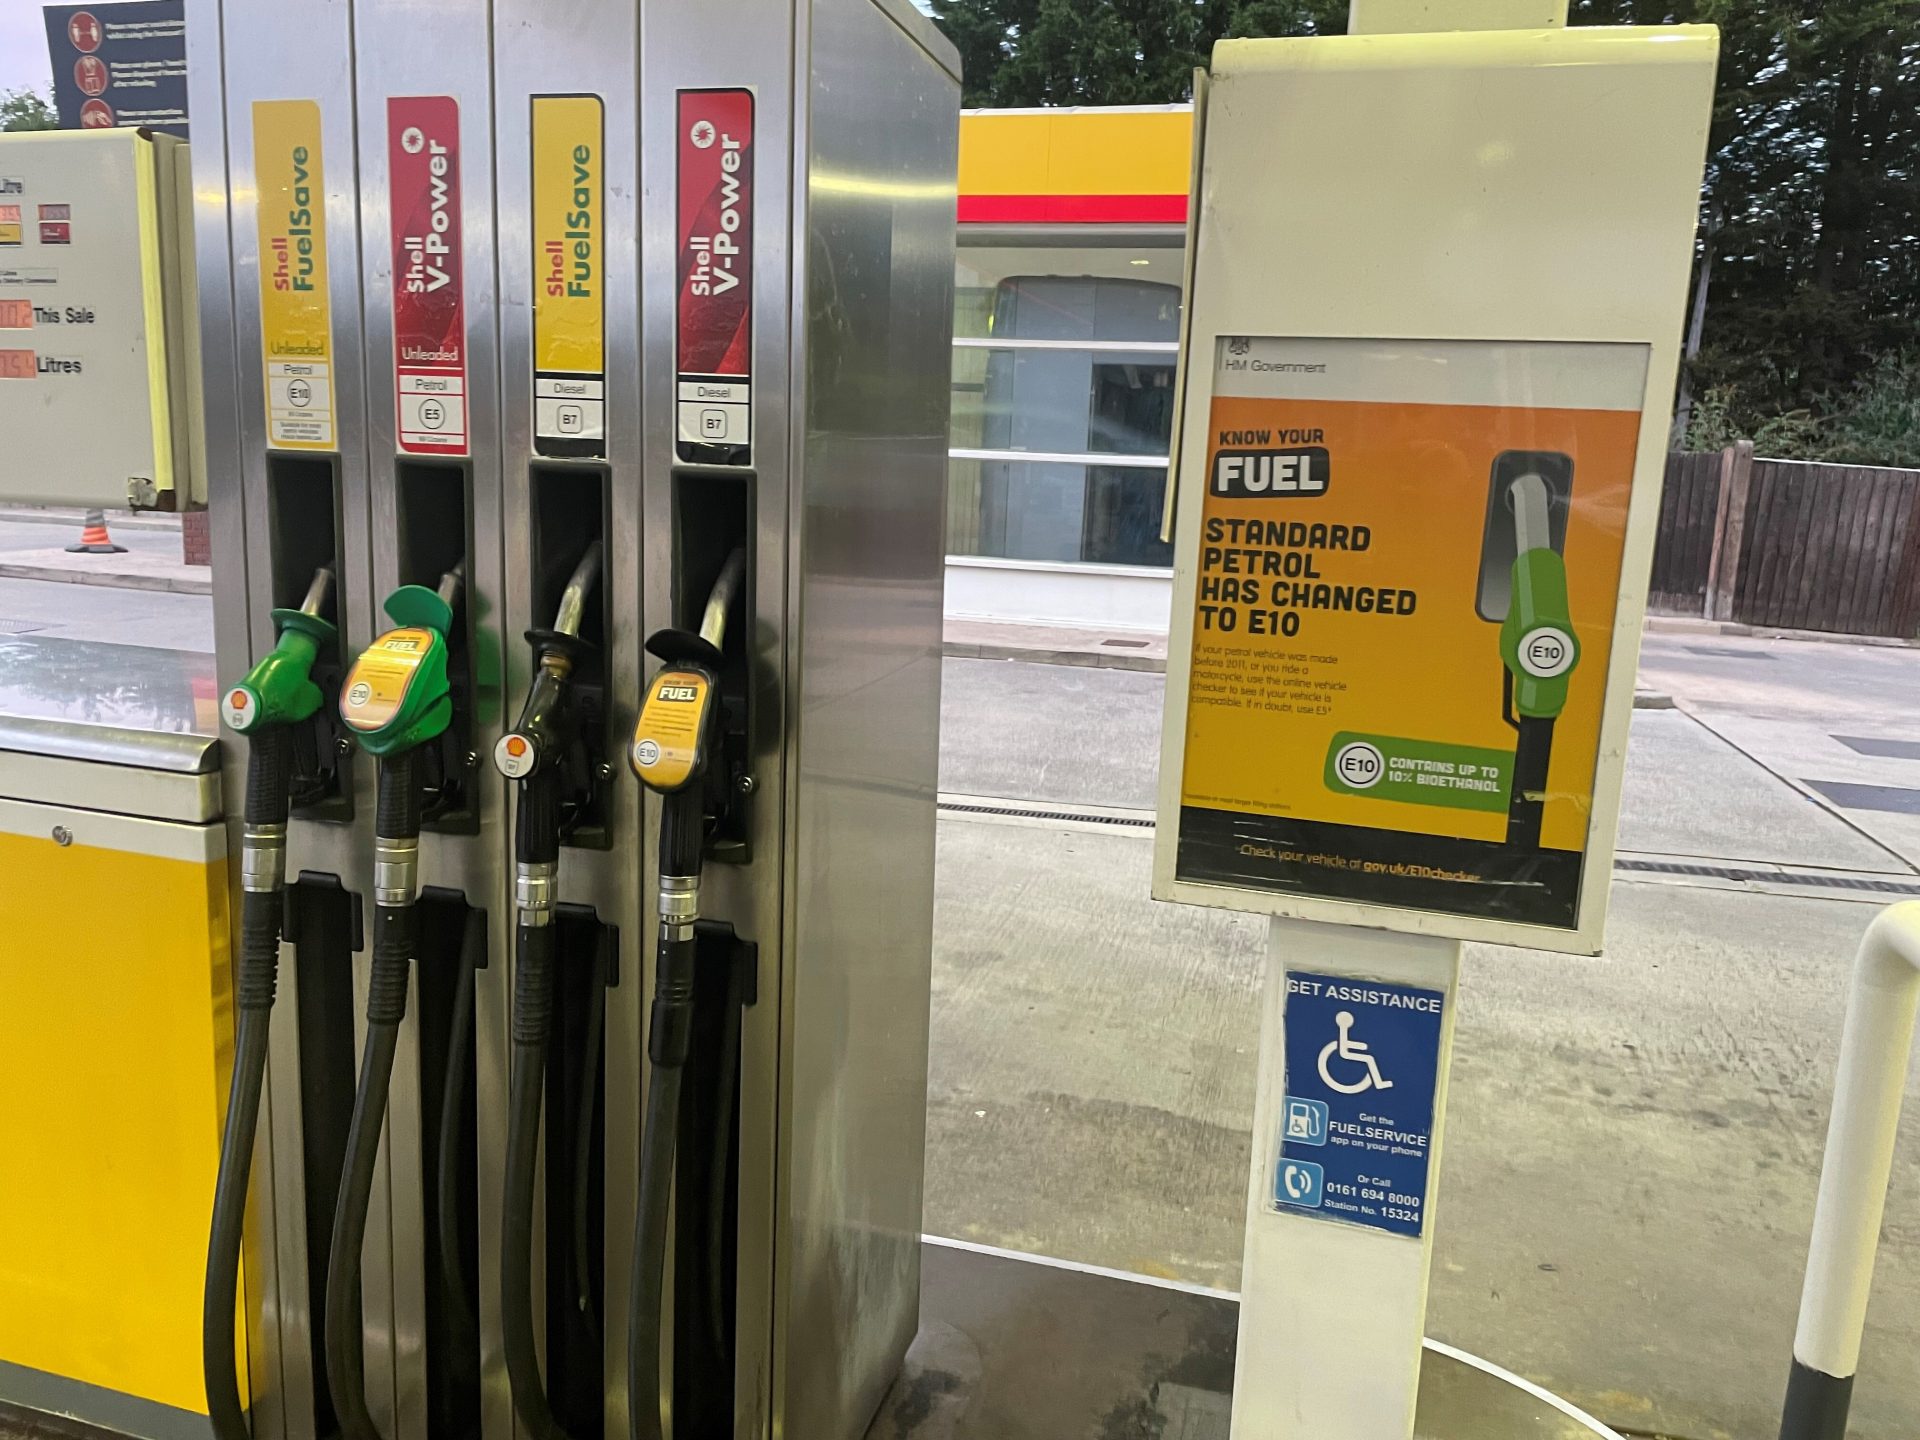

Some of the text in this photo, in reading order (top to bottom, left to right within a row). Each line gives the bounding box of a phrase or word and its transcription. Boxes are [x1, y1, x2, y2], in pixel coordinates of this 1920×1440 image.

[288, 146, 315, 291] FuelSave
[426, 139, 450, 292] V-Power
[565, 145, 591, 298] FuelSave
[713, 134, 740, 296] V-Power
[271, 238, 290, 291] Shell
[404, 237, 424, 293] Shell
[545, 241, 564, 297] Shell
[690, 236, 710, 296] Shell
[33, 307, 94, 323] This Sale
[271, 340, 325, 355] Unleaded
[402, 345, 458, 361] Unleaded
[37, 356, 82, 373] Litres
[284, 364, 313, 375] Petrol
[1225, 359, 1327, 373] HM Government
[290, 388, 310, 399] E10
[415, 378, 447, 391] Petrol
[553, 383, 586, 394] Diesel
[697, 387, 731, 398] Diesel
[425, 409, 440, 420] E5
[563, 415, 577, 424] B7
[706, 419, 722, 429] B7
[1219, 429, 1324, 445] KNOW YOUR
[1218, 455, 1324, 492] FUEL
[1205, 517, 1371, 551] STANDARD
[1203, 547, 1320, 579] PETROL
[1201, 576, 1417, 616] HAS CHANGED
[1199, 606, 1300, 637] TO E10
[1532, 646, 1560, 659] E10
[659, 687, 695, 700] FUEL
[639, 747, 656, 758] E10
[1344, 758, 1374, 773] E10
[1389, 757, 1499, 778] CONTAINS UP TO
[1388, 771, 1501, 793] 10% BIOETHANOL
[1241, 844, 1276, 859] Check
[1279, 850, 1304, 862] your
[1306, 853, 1346, 867] vehicle
[1364, 860, 1481, 884] gov.uk/E10checker
[1288, 979, 1441, 1013] GET ASSISTANCE
[1359, 1113, 1394, 1126] Get the
[1329, 1121, 1427, 1147] FUELSERVICE
[1331, 1136, 1423, 1157] app on your phone
[1357, 1174, 1391, 1188] Or Call
[1327, 1182, 1419, 1207] 0161 694 8000
[1324, 1199, 1419, 1223] Station No. 15324
